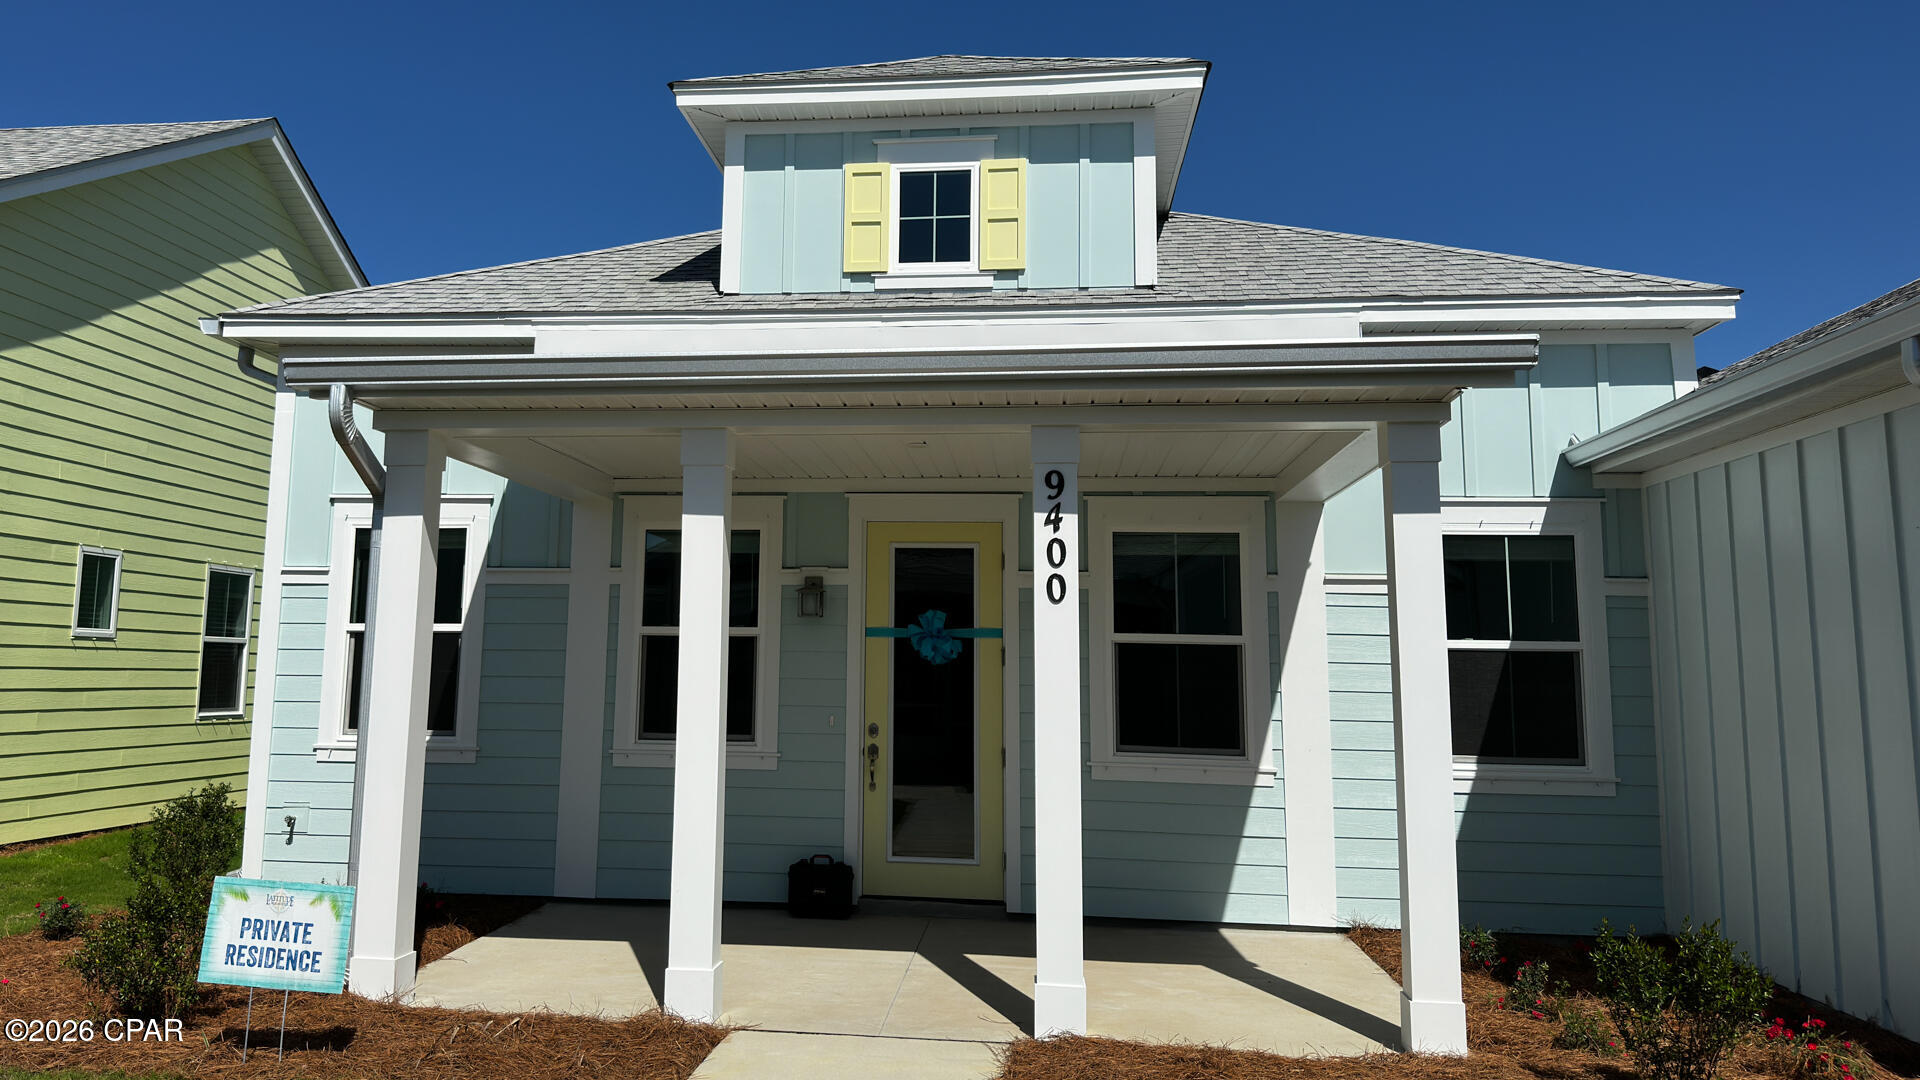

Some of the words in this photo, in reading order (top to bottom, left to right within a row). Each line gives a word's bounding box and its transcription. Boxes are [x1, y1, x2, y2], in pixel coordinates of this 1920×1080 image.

[1044, 469, 1067, 605] 9400
[239, 917, 314, 944] PRIVATE
[224, 943, 323, 973] RESIDENCE
